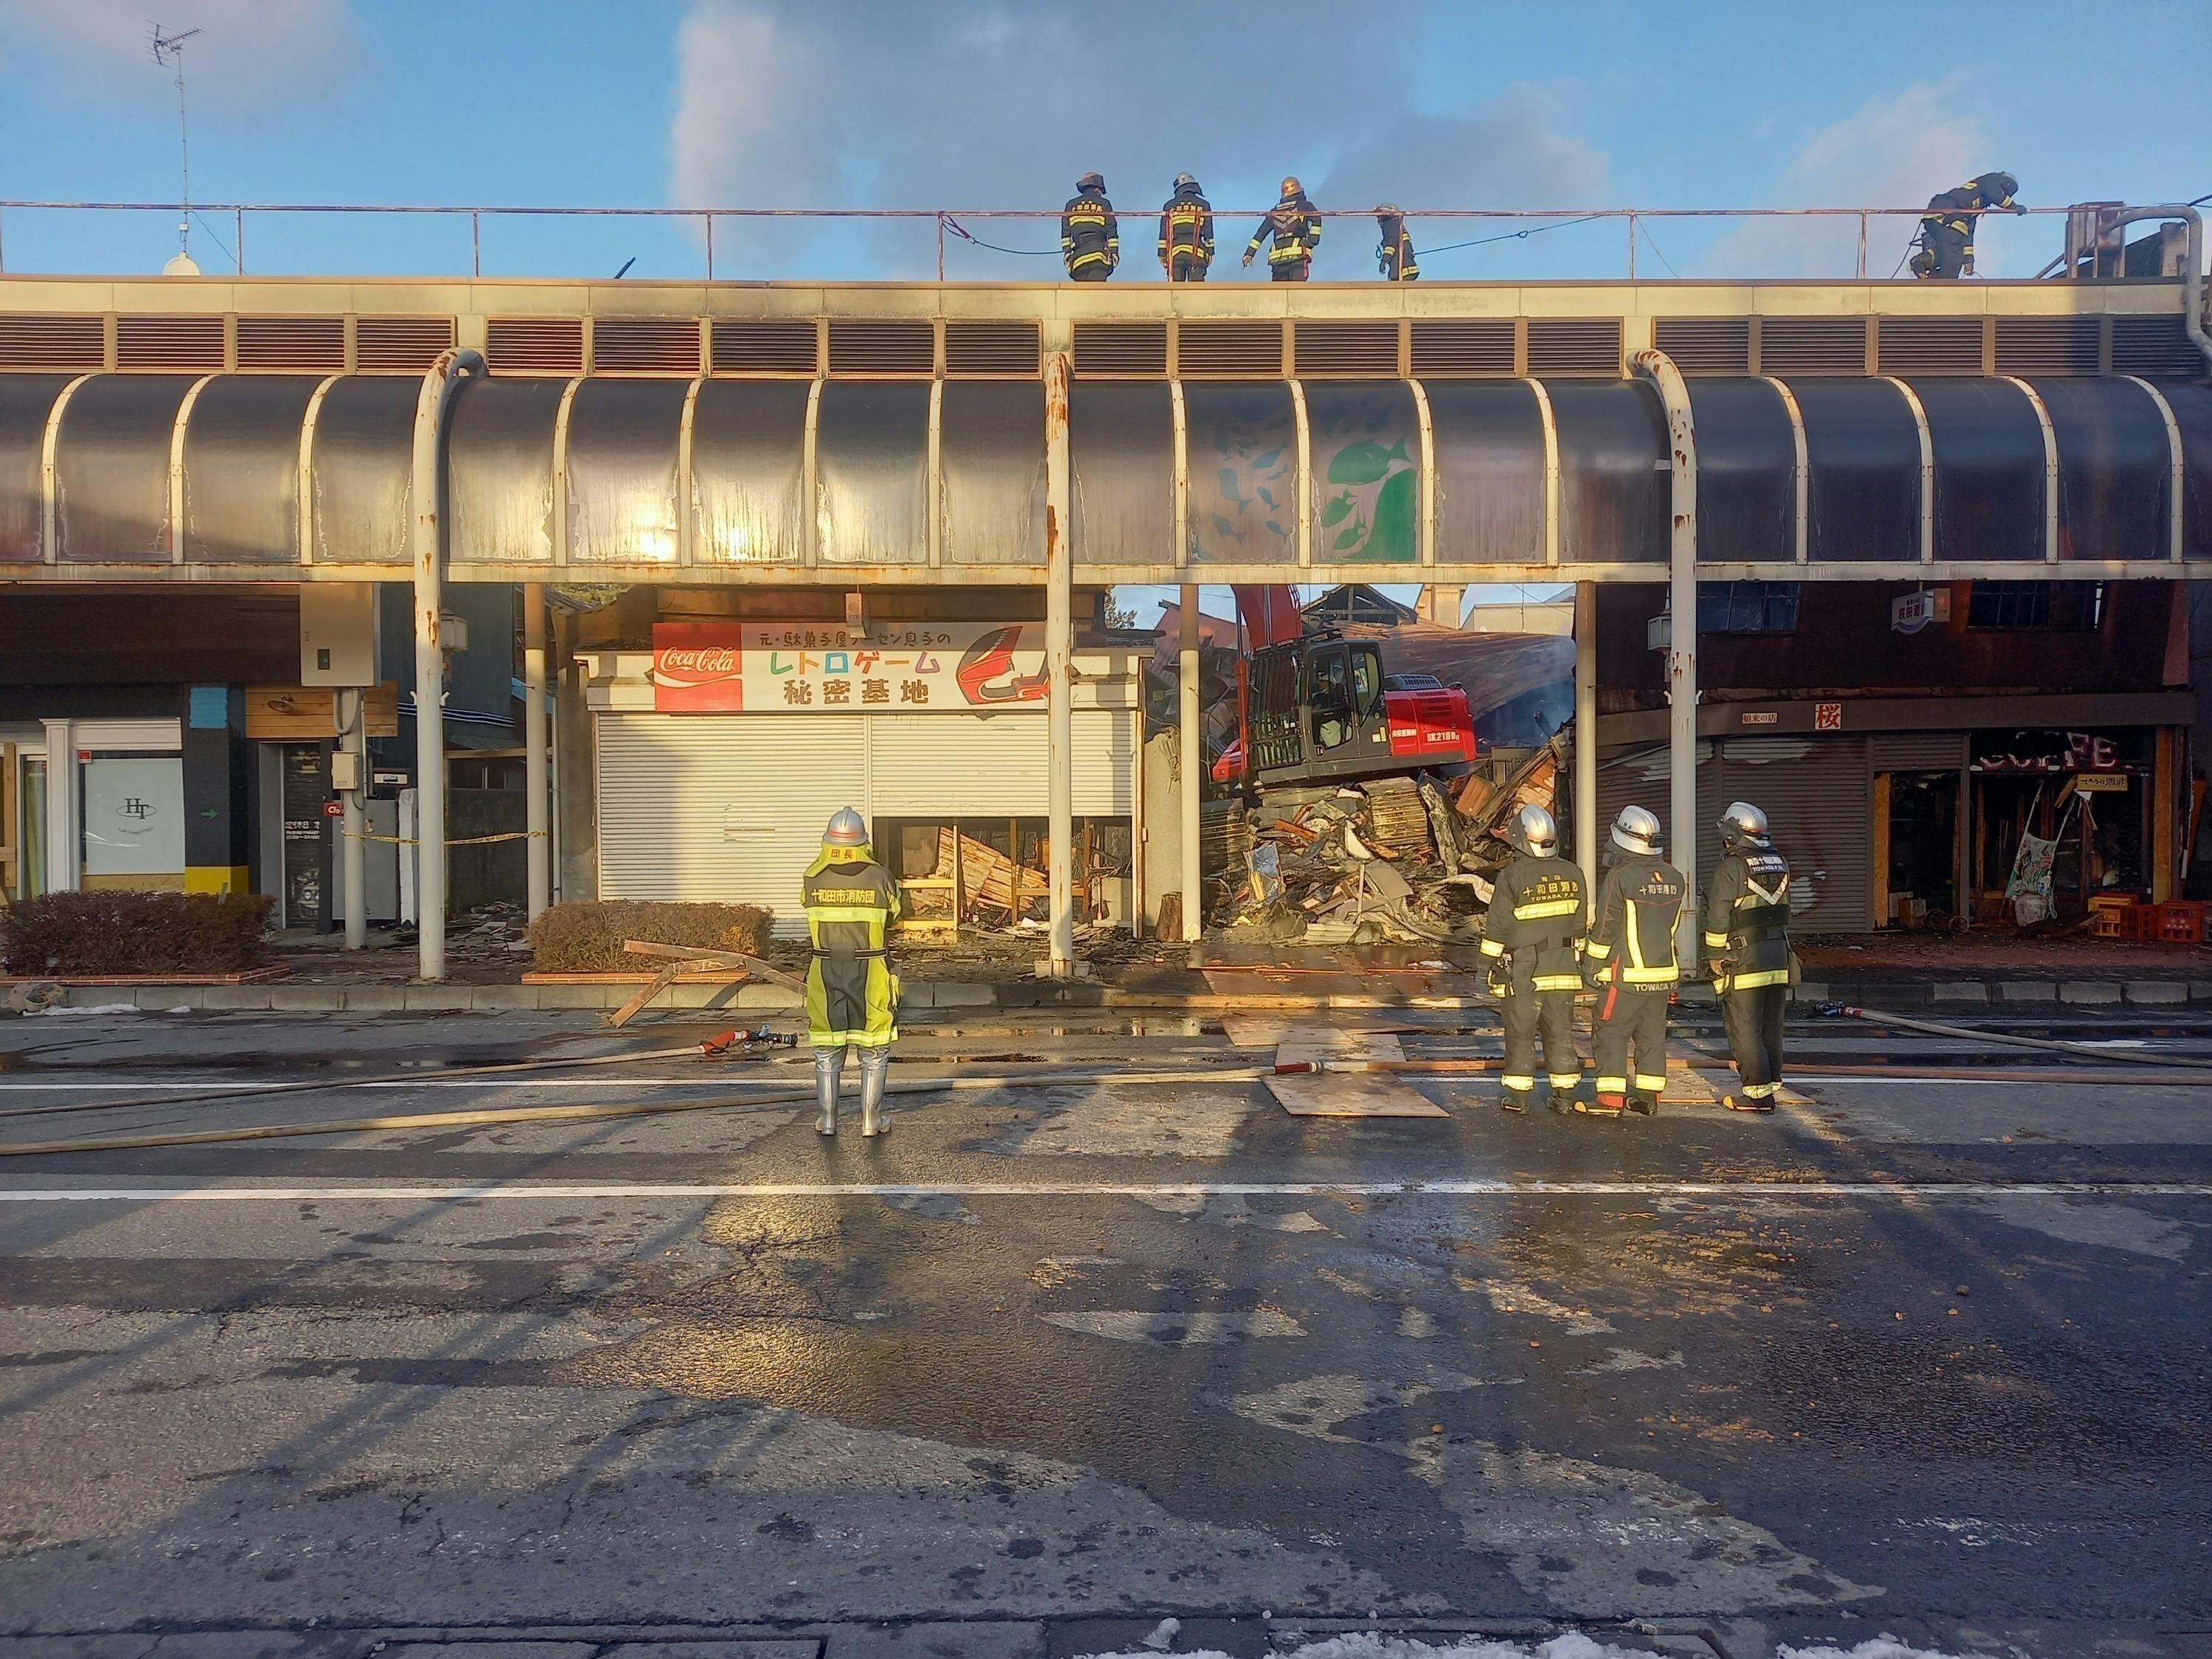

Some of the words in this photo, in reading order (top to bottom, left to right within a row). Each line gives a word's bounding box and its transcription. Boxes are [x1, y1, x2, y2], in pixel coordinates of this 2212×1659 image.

[660, 646, 737, 672] Coca-Cola
[770, 650, 941, 675] レトロゲーム
[784, 678, 929, 705] 秘密基地
[1816, 704, 1840, 729] 桜
[831, 849, 853, 860] 団長
[811, 888, 876, 905] 十和田市消防団
[1531, 893, 1562, 902] TOWADA
[1634, 982, 1669, 992] TOWADA
